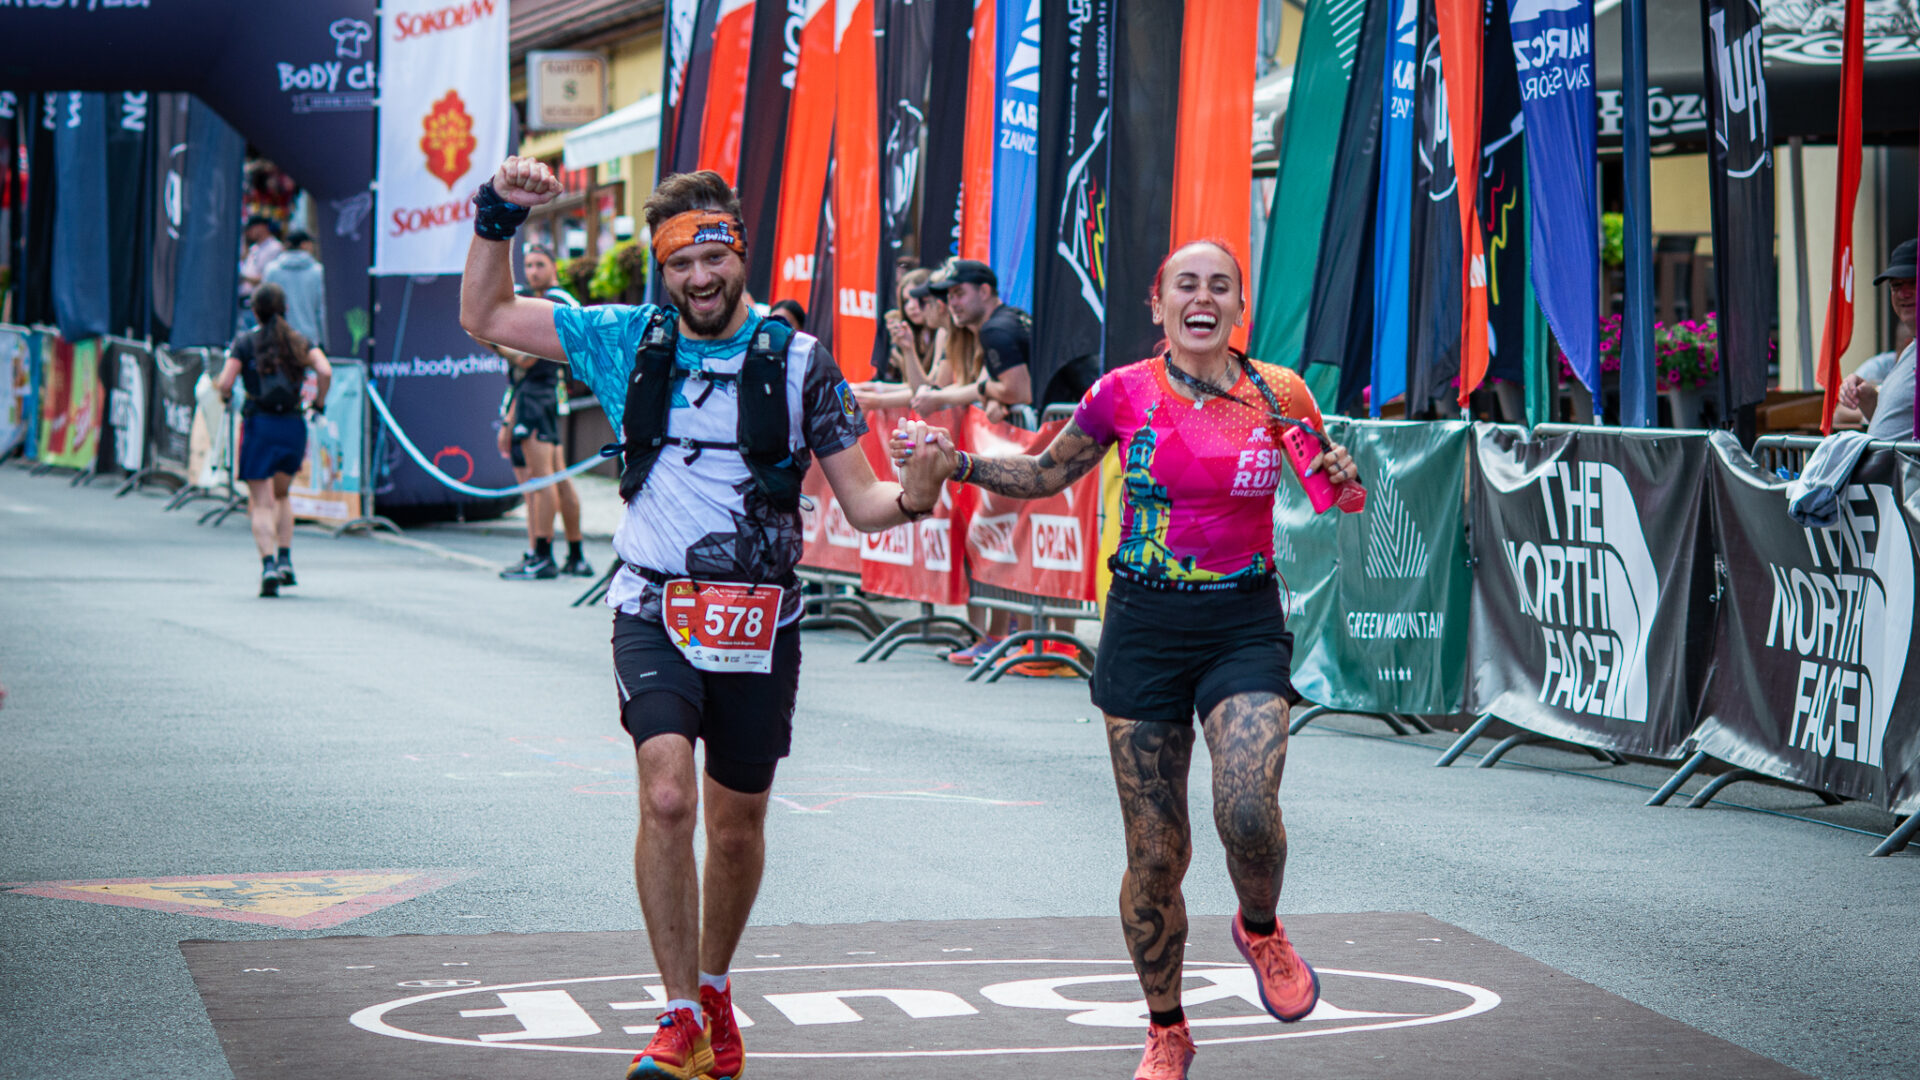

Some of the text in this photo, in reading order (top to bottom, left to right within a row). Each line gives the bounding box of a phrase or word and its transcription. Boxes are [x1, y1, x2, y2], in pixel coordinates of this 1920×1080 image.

[1233, 470, 1281, 489] RUN
[1540, 461, 1602, 544] THE
[704, 603, 764, 638] 578
[1346, 611, 1385, 639] GREEN
[1502, 539, 1609, 631] NORTH
[1766, 562, 1868, 665] NORTH
[1538, 625, 1612, 716] FACE
[1788, 660, 1858, 761] FACE
